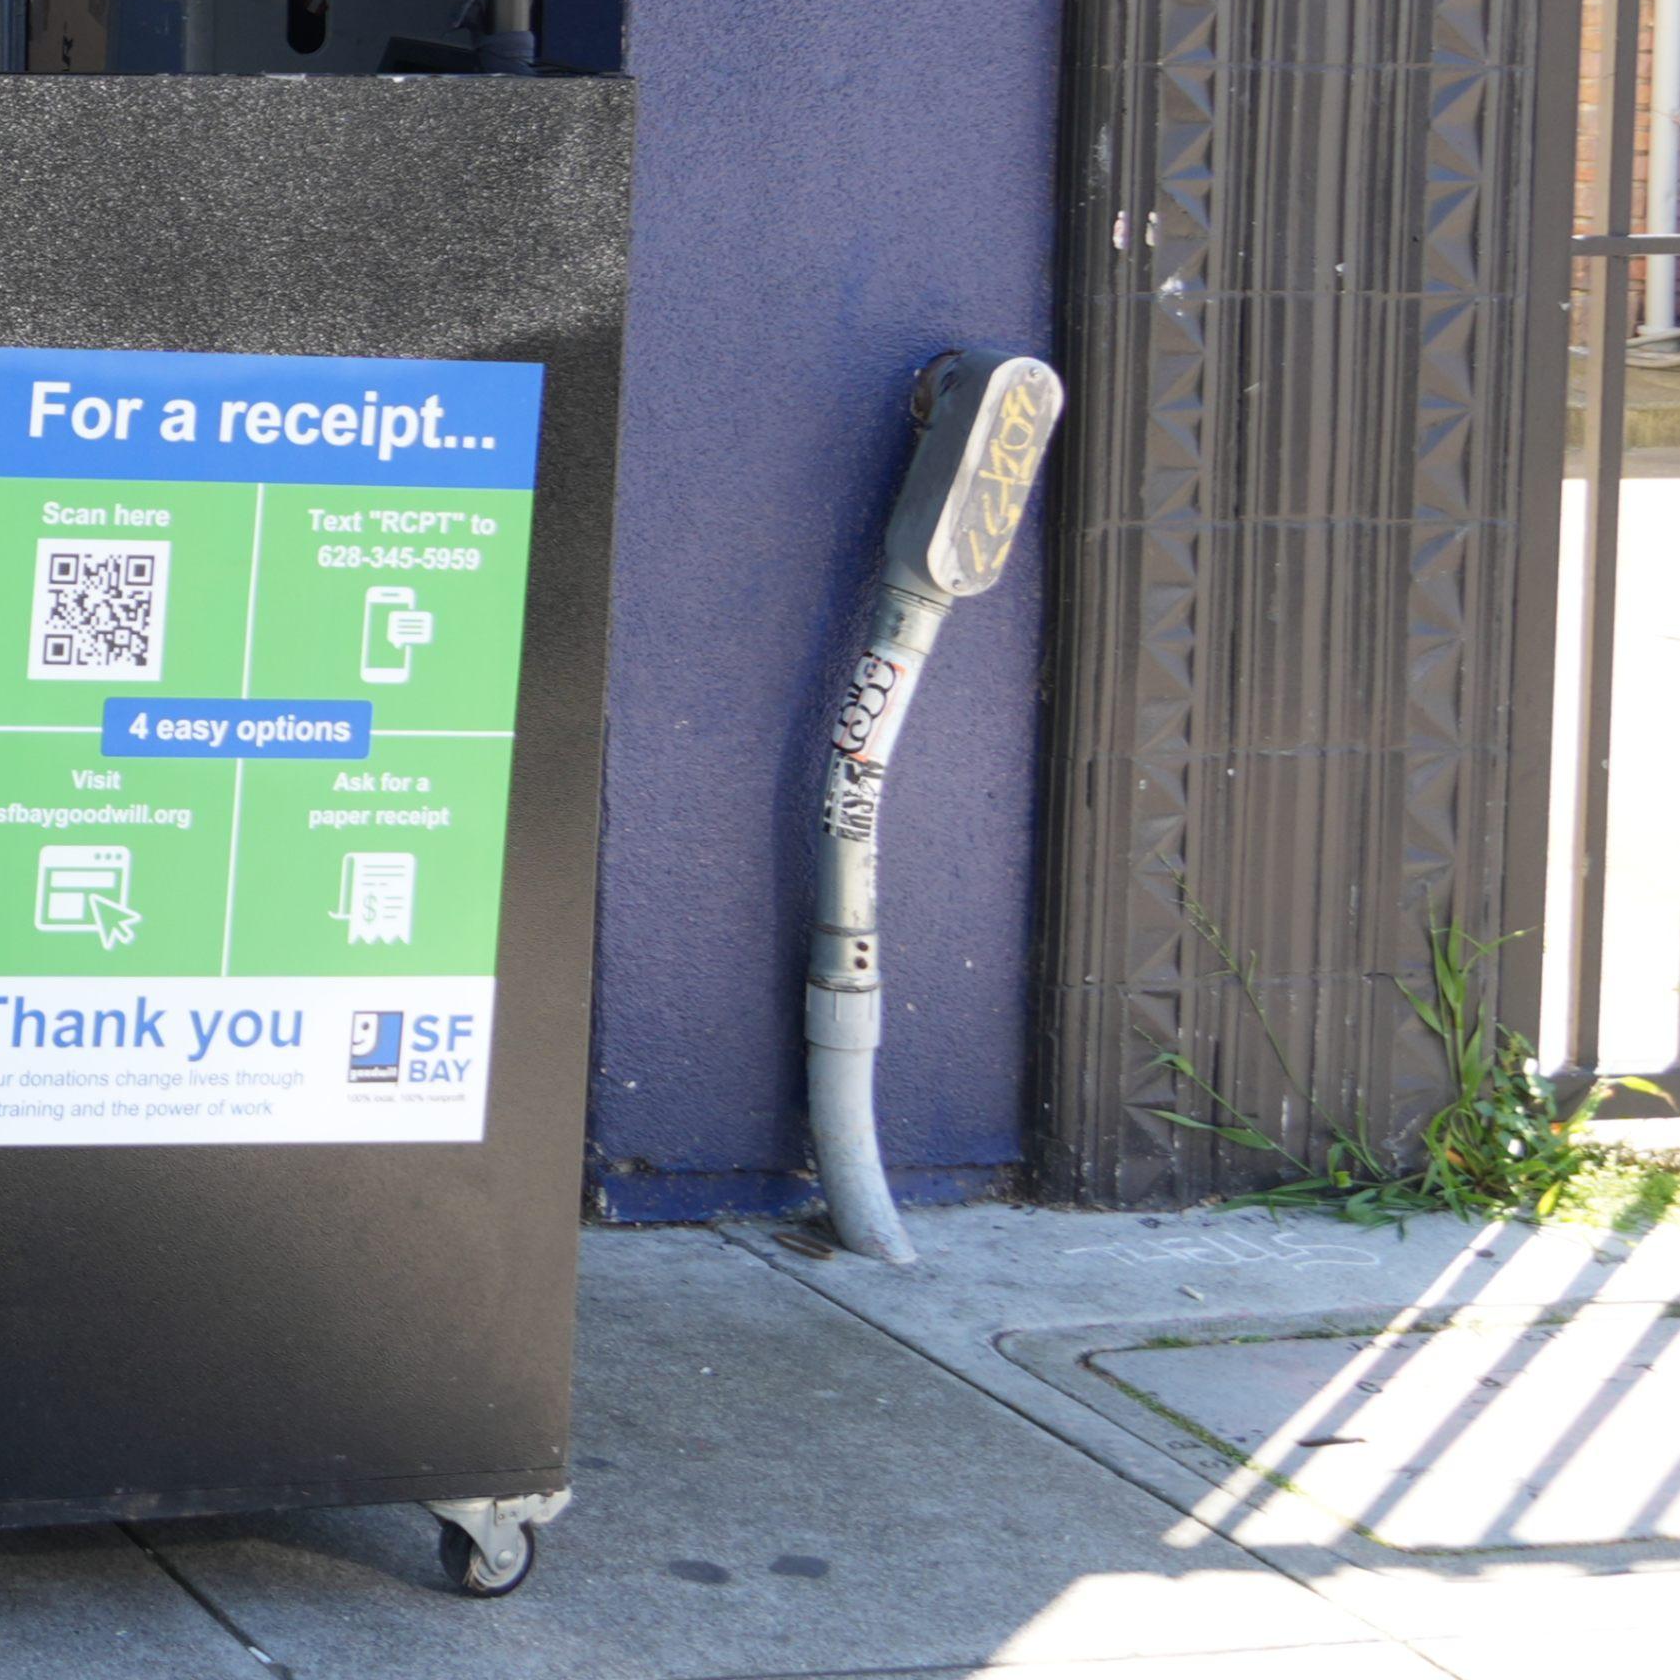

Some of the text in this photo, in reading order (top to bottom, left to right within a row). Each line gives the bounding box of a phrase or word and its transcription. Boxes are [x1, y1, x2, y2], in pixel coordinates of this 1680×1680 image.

[29, 380, 496, 462] For a receipt...
[42, 501, 171, 528] Scan here
[308, 508, 498, 536] Text "RCPT" to
[317, 545, 481, 571] 628-345-5959
[129, 712, 352, 748] 4 easy options
[71, 769, 121, 791] Visit
[333, 772, 430, 793] Ask for a
[309, 807, 450, 831] paper receipt
[186, 1009, 304, 1063] you
[411, 1014, 474, 1053] SF
[19, 1069, 109, 1088] donations
[115, 1070, 183, 1091] change
[188, 1069, 230, 1088] lives
[236, 1069, 305, 1091] through
[409, 1059, 471, 1083] BAY
[70, 1100, 105, 1118] and
[112, 1099, 139, 1118] the
[145, 1102, 201, 1121] power
[207, 1099, 225, 1117] of
[230, 1099, 274, 1117] work
